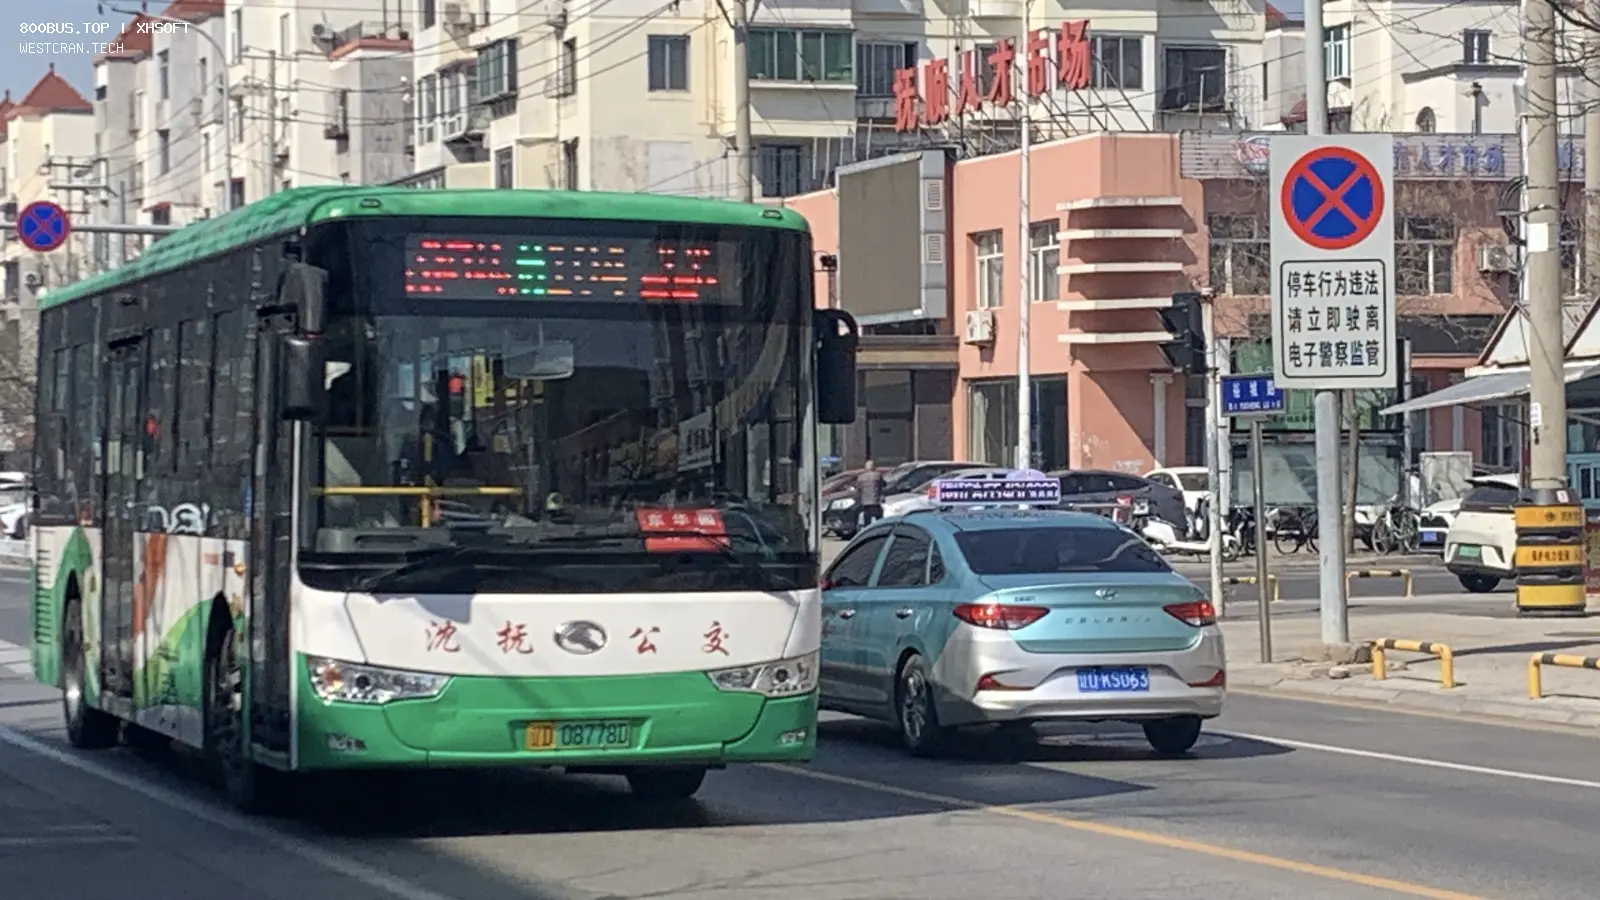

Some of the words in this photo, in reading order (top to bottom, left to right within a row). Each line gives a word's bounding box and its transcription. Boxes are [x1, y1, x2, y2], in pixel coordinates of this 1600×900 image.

[892, 19, 1091, 132] 抚顺人才市场
[1287, 269, 1380, 298] 停车行为违法
[1288, 305, 1380, 334] 请立即驶离
[1289, 341, 1380, 368] 电子警察监管
